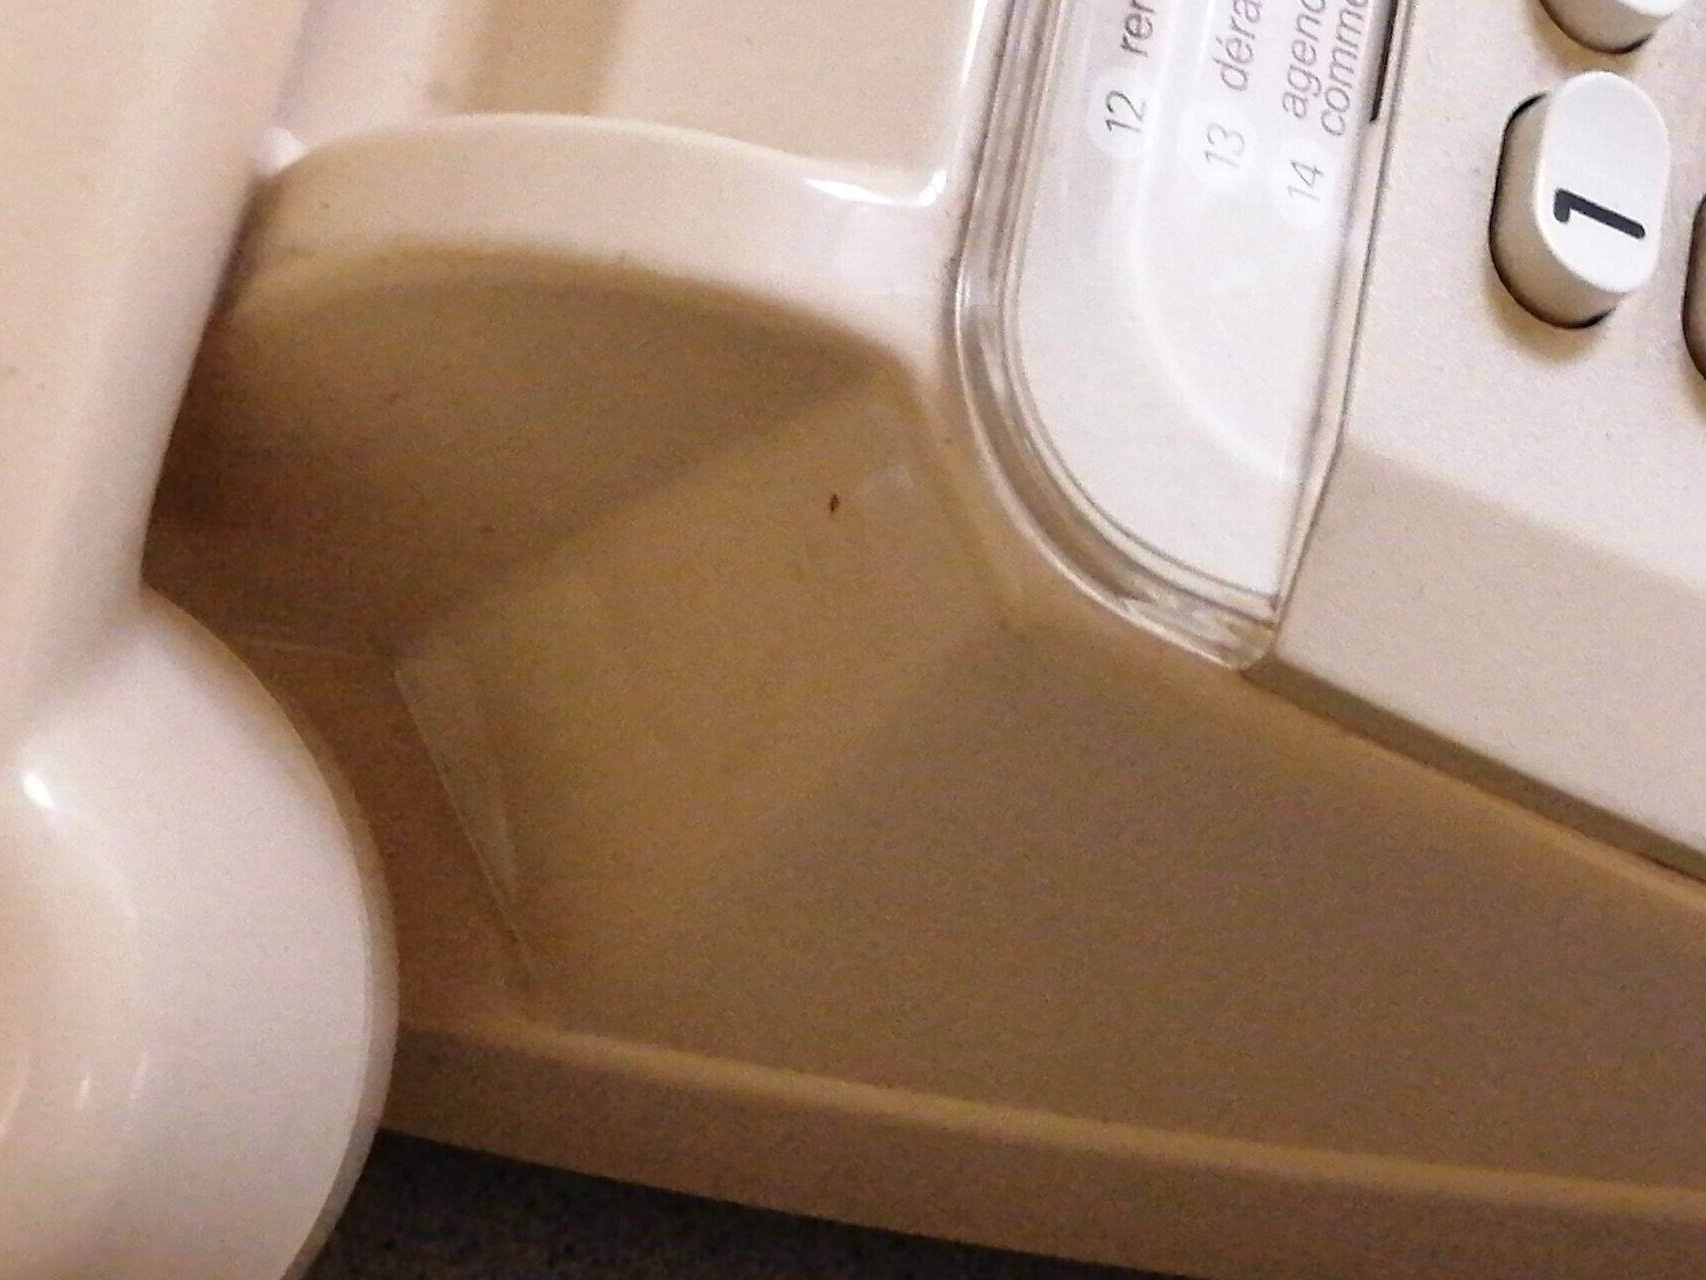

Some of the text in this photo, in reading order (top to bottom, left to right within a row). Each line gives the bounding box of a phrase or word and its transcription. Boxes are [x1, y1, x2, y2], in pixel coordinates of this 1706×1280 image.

[1104, 90, 1146, 135] 12
[1203, 122, 1246, 169] 13
[1287, 159, 1324, 203] 14
[1552, 187, 1646, 241] 1
